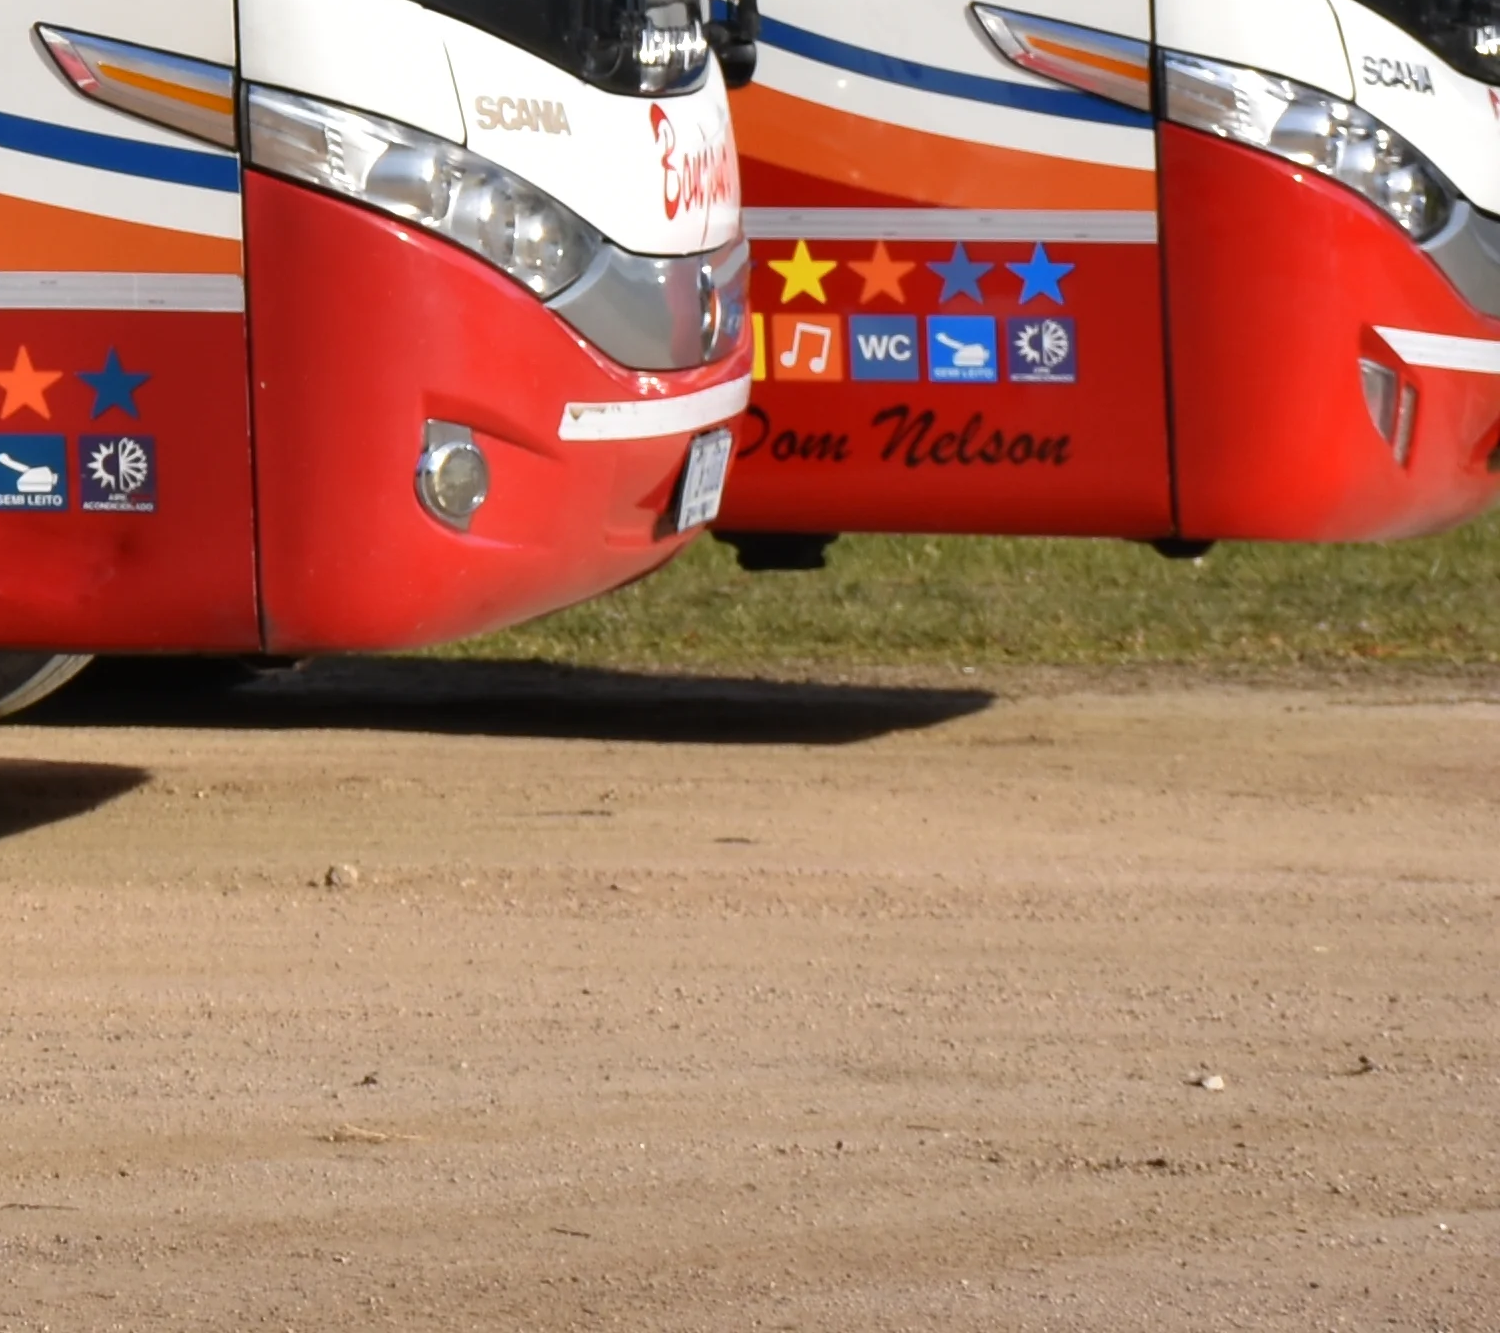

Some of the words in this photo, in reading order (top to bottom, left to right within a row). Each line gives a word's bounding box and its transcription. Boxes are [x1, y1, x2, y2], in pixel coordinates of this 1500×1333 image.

[474, 95, 572, 136] SCANIA
[857, 335, 912, 362] WC
[871, 401, 1071, 468] Nelson
